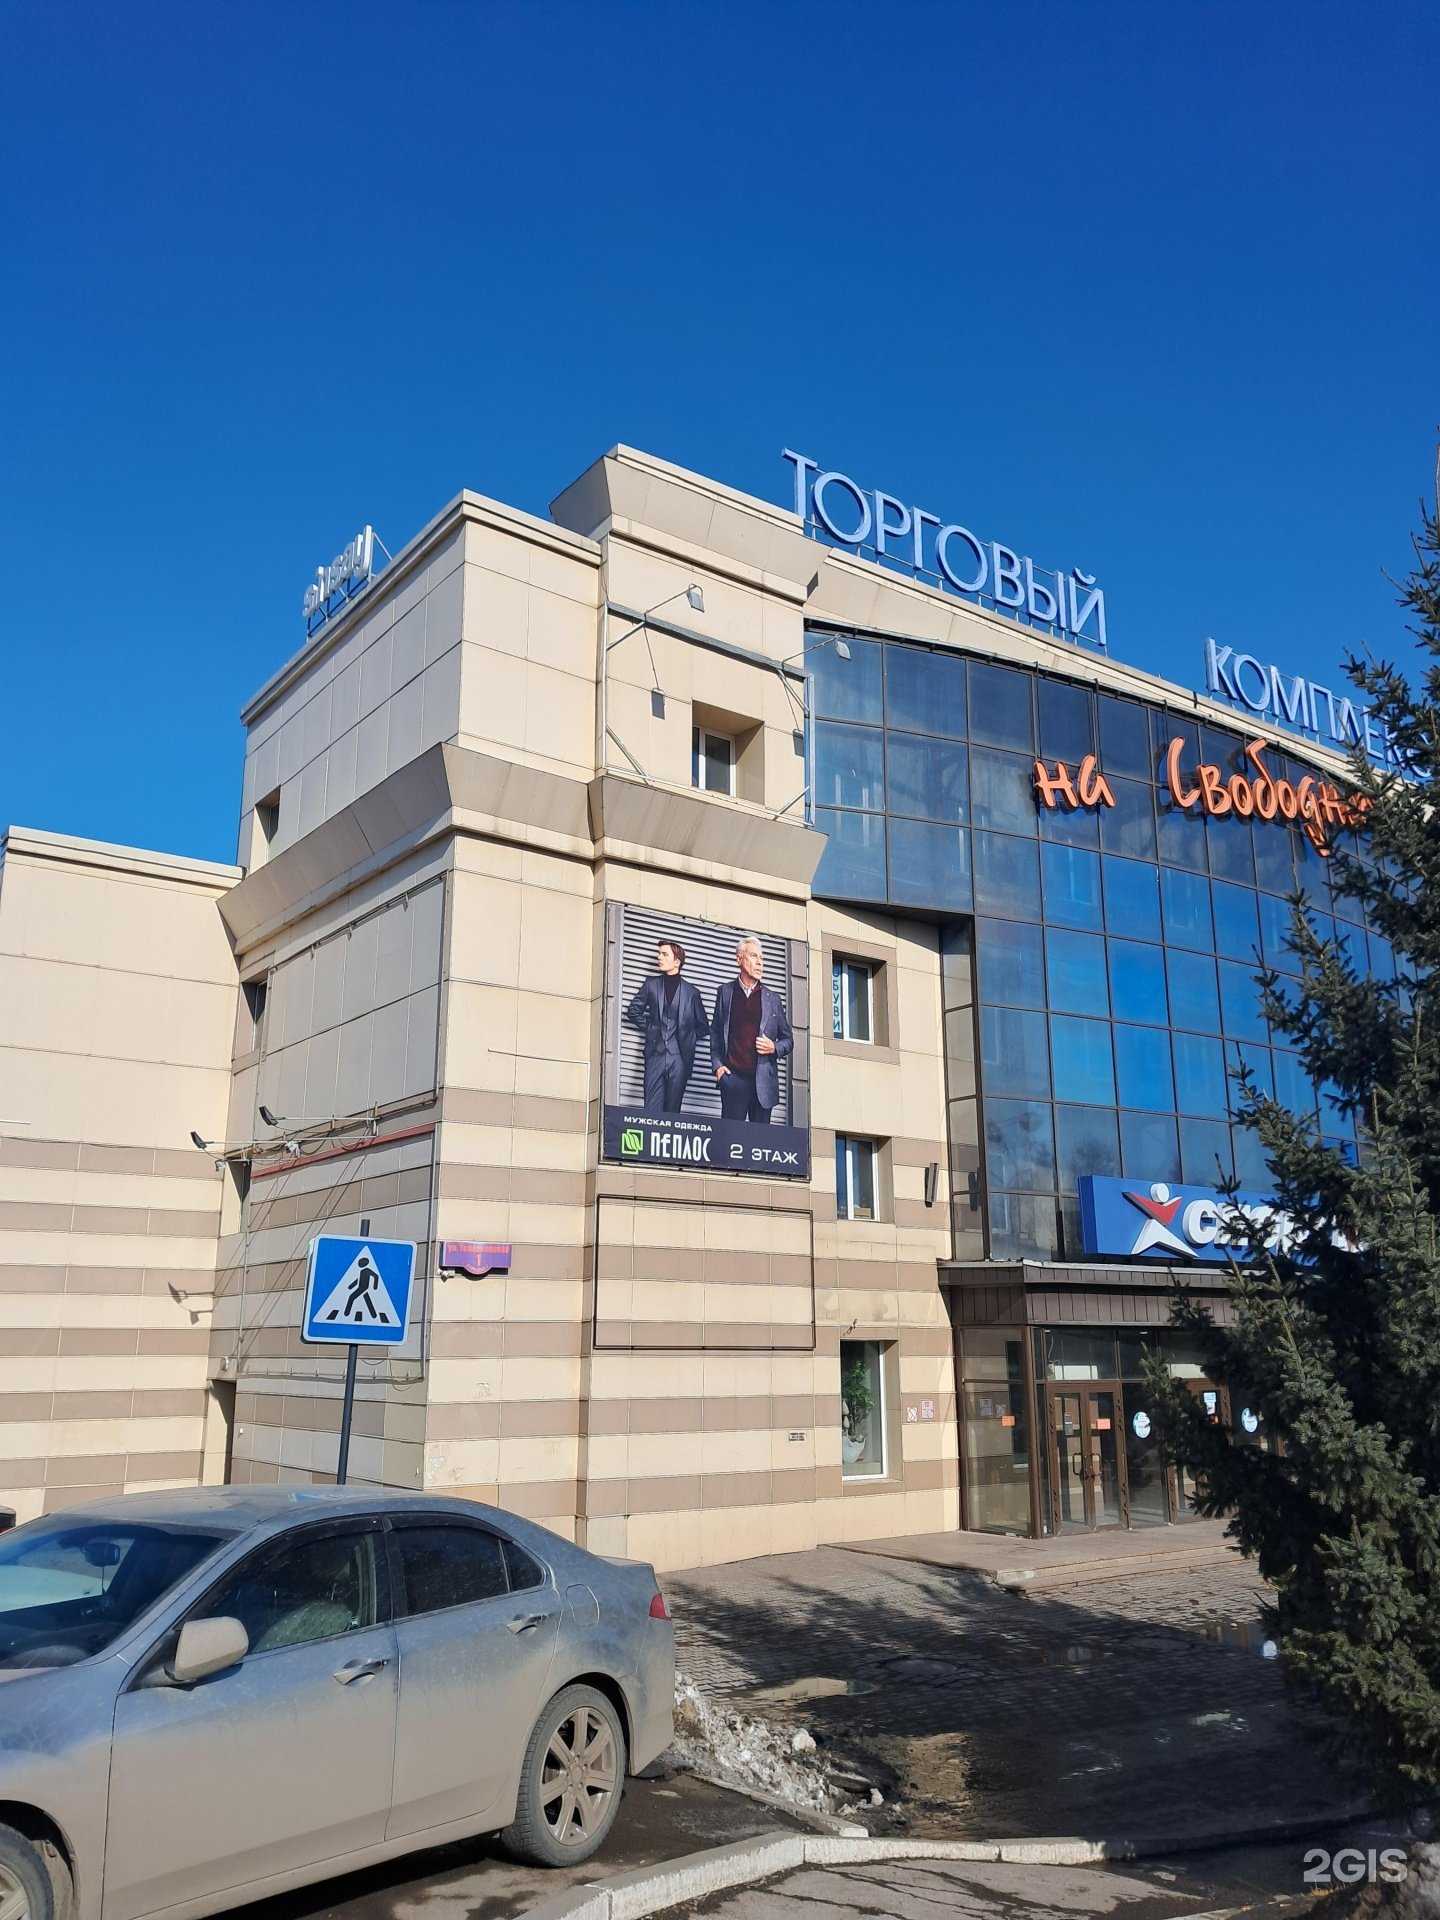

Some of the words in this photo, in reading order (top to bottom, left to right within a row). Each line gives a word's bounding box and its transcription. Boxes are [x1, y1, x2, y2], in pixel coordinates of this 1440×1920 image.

[782, 447, 1107, 646] ТОРГОВЫЙ
[623, 1115, 672, 1128] МУЖСКАЯ
[674, 1121, 713, 1133] ОДЕЖДА
[650, 1131, 712, 1162] ПЕПЛОС
[730, 1143, 744, 1160] 2
[751, 1148, 799, 1165] ЭТАЖ
